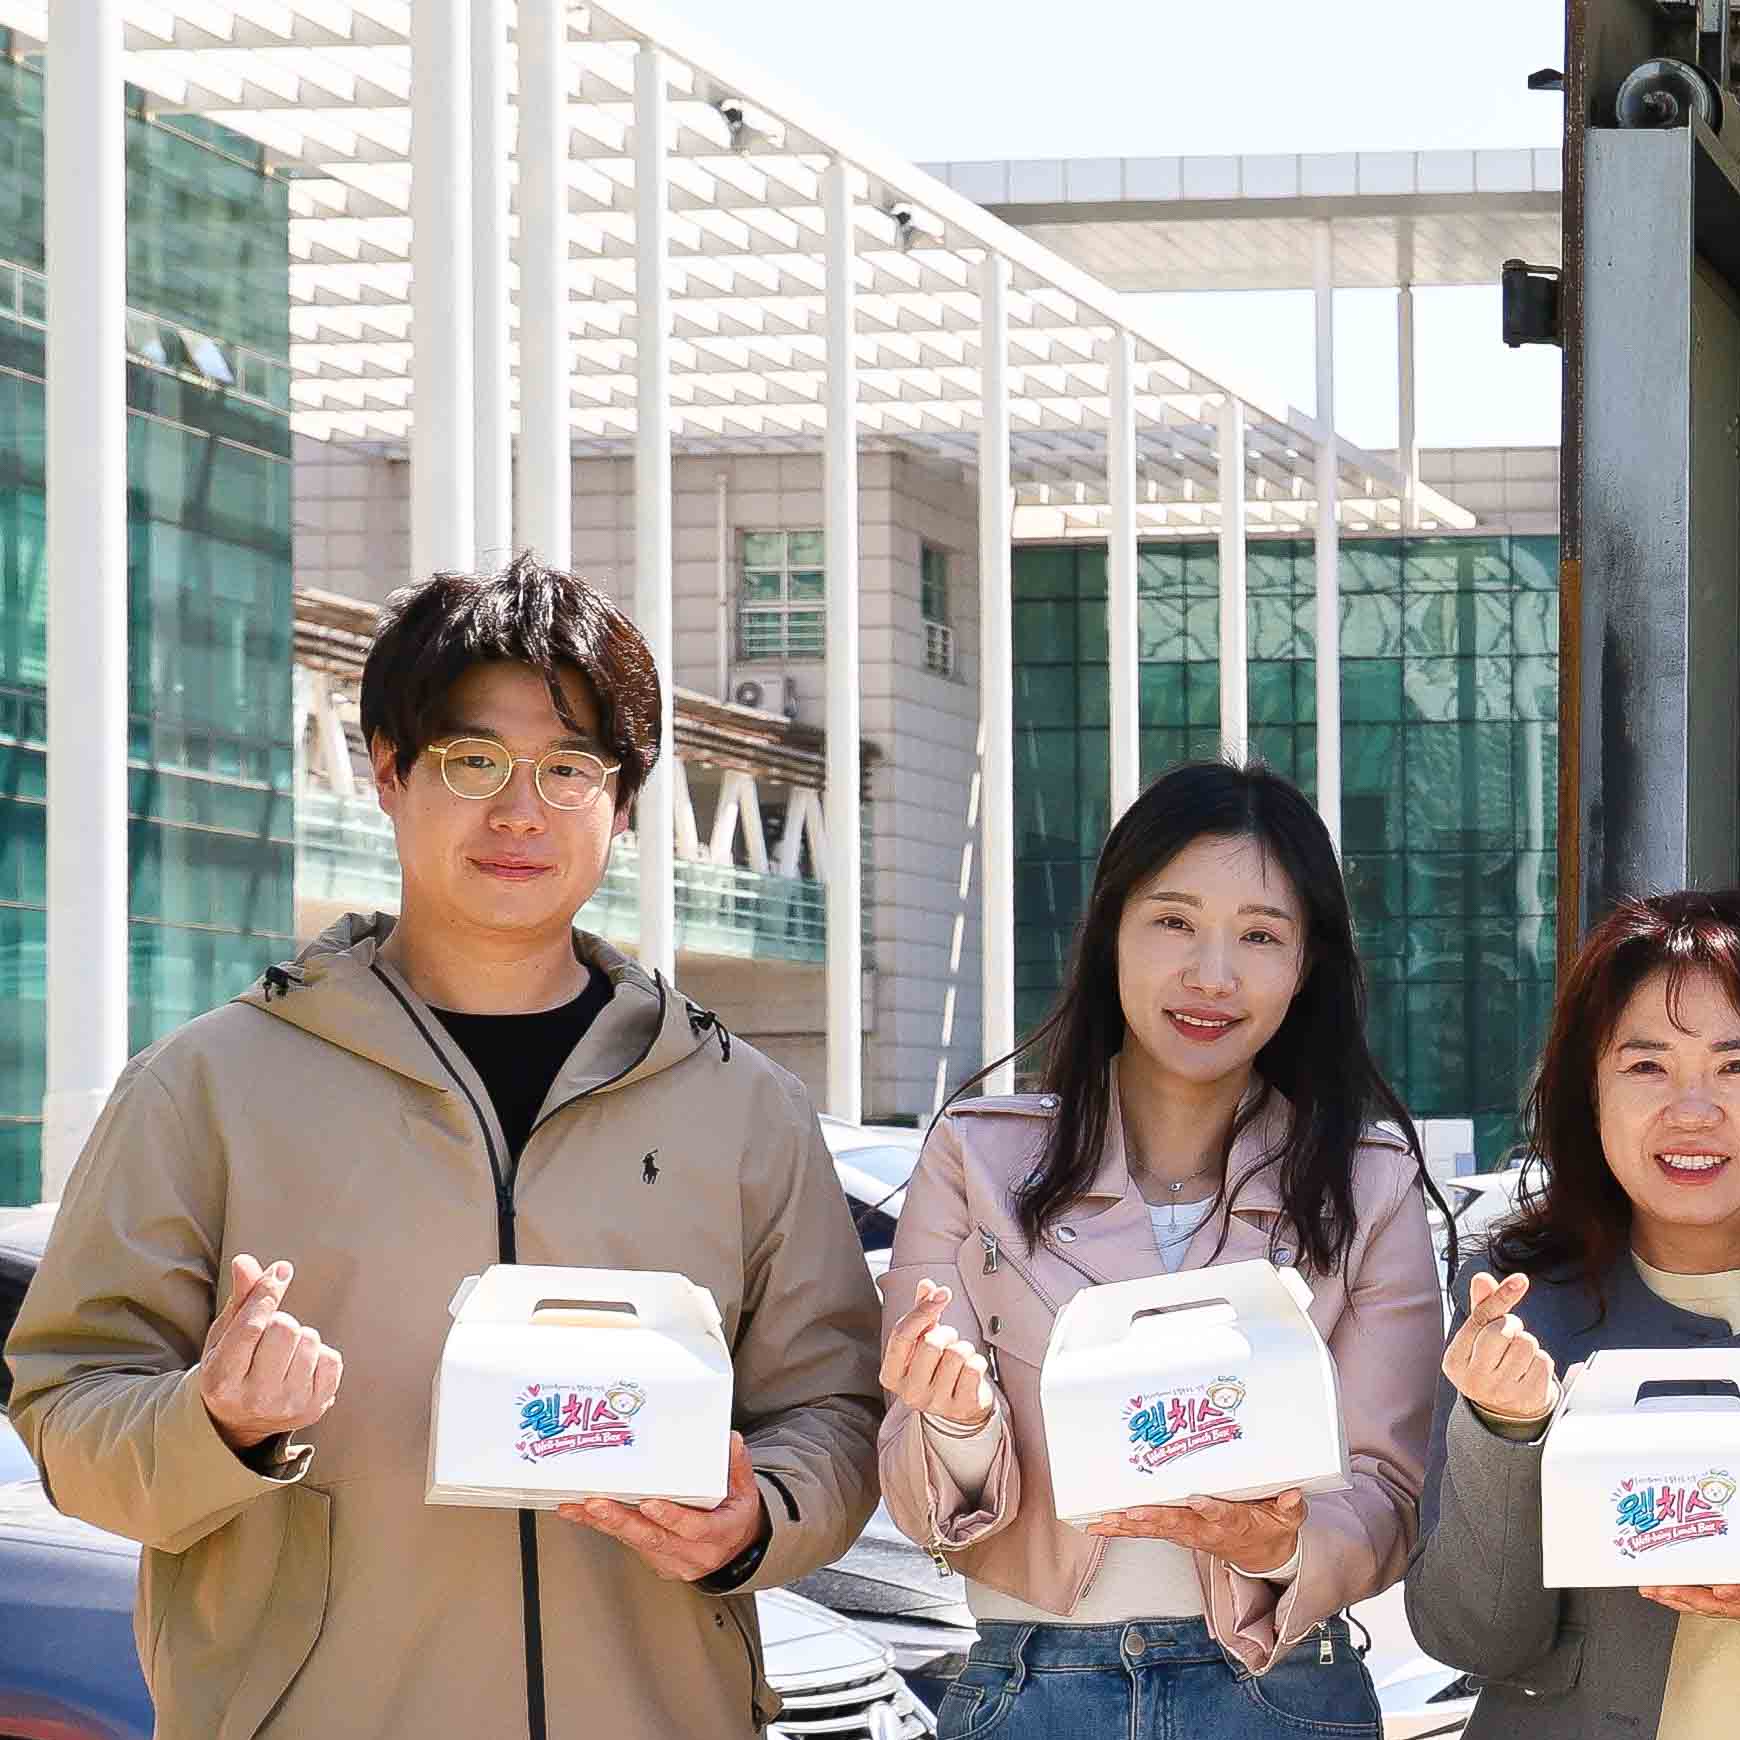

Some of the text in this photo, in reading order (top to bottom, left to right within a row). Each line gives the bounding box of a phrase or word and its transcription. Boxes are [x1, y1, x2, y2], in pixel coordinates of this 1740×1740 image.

[520, 1393, 629, 1439] 웰치스
[1128, 1398, 1233, 1448] 웰치스
[1616, 1486, 1722, 1534] 웰치스
